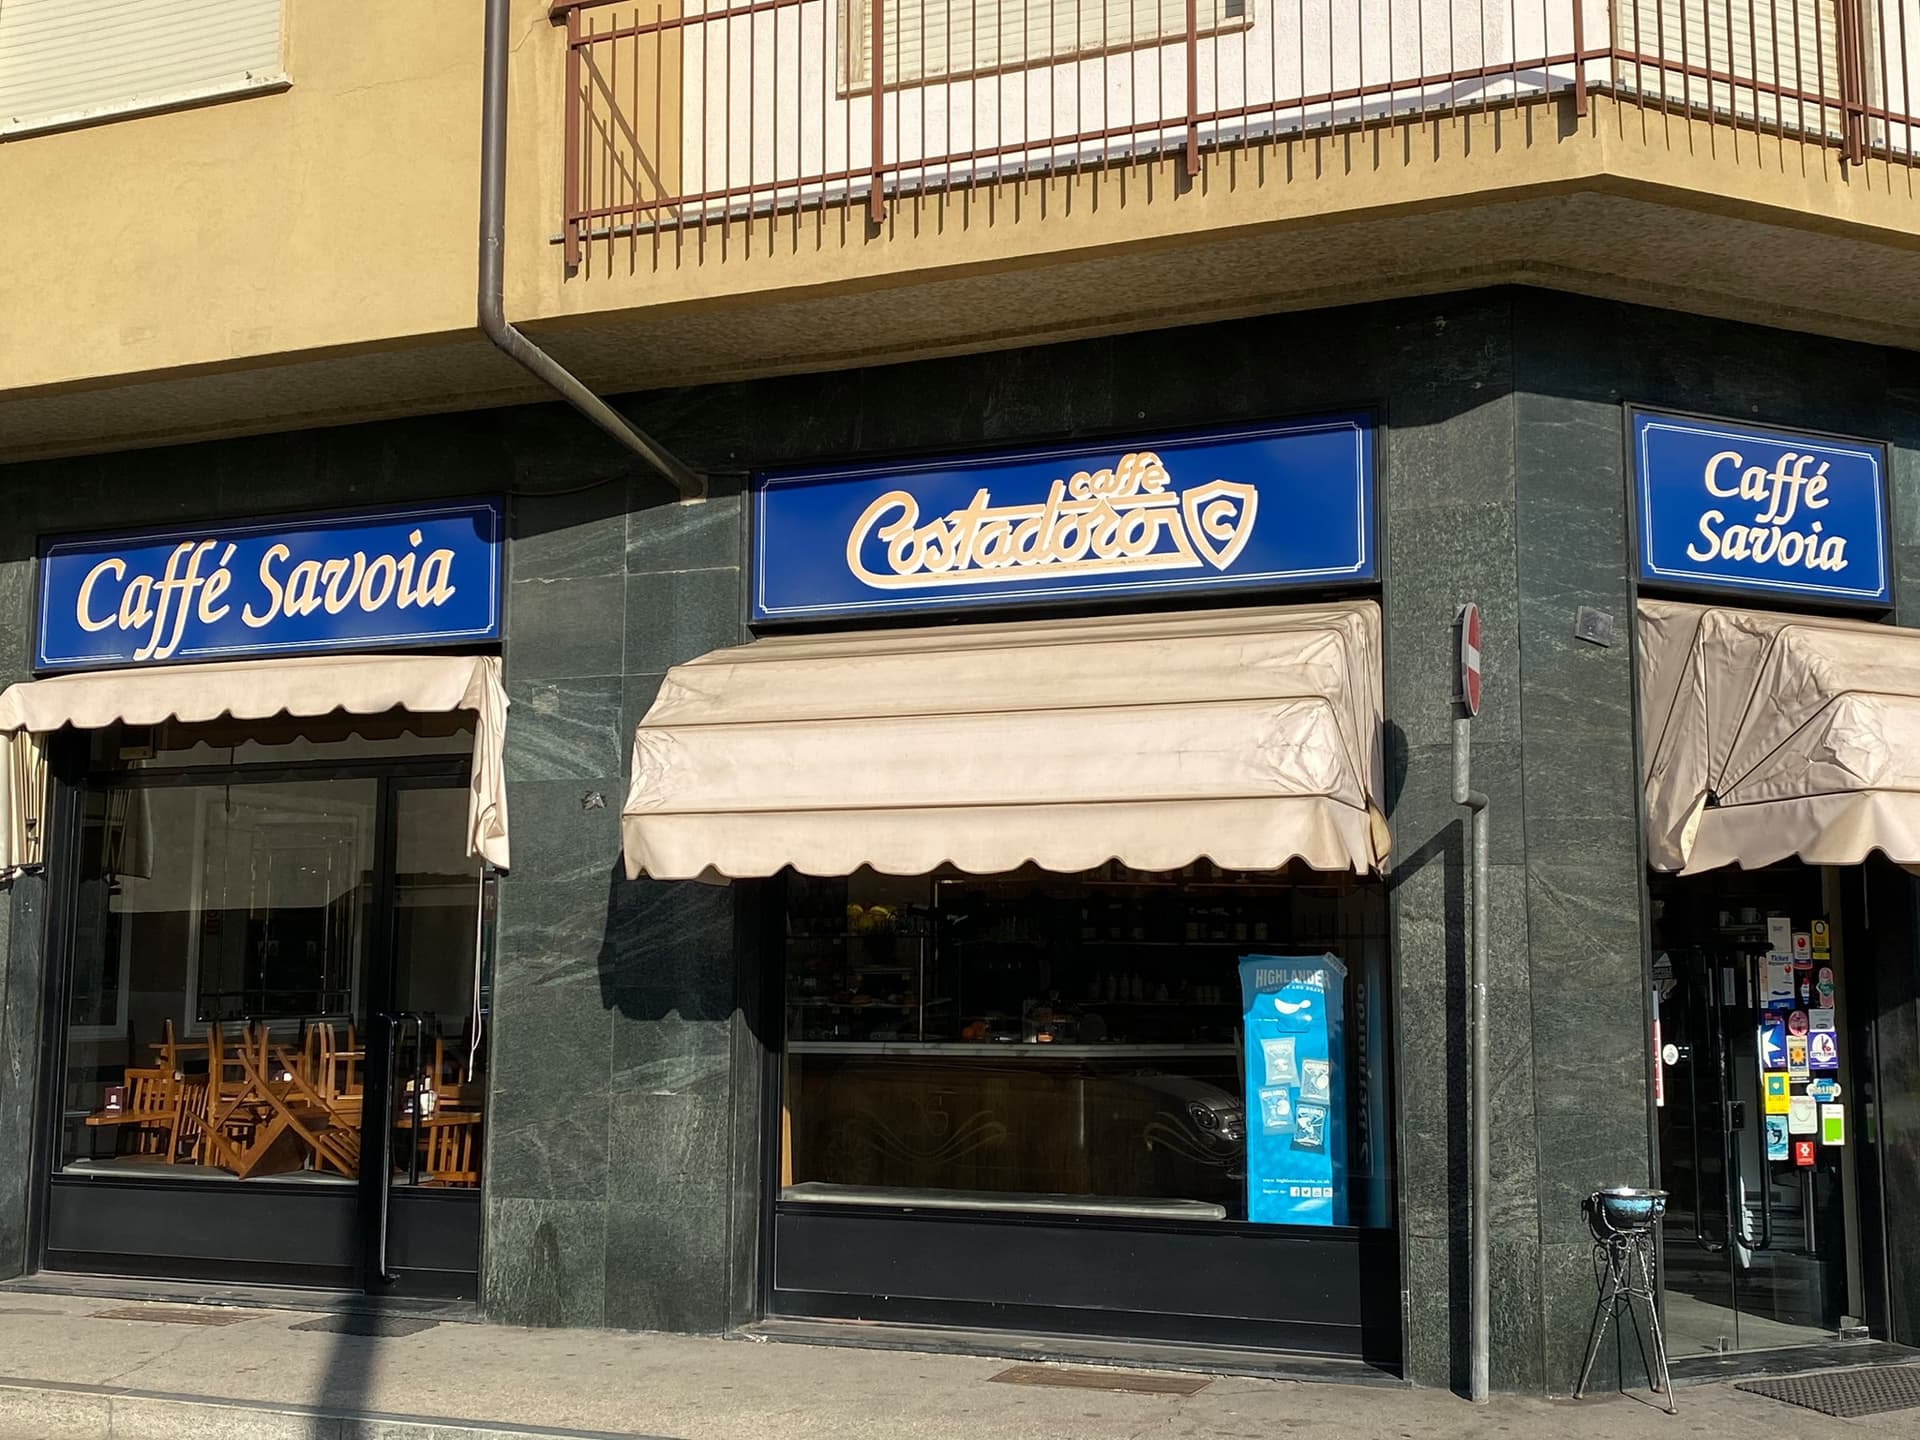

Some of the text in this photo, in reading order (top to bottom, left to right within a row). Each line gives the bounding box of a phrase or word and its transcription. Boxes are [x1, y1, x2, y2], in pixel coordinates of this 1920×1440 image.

[1704, 451, 1830, 526] Caffé
[846, 478, 1204, 590] Costadoro
[1686, 510, 1849, 573] Savoia
[76, 528, 457, 661] Caffé Savoia
[1255, 968, 1332, 990] HIGHLANDER
